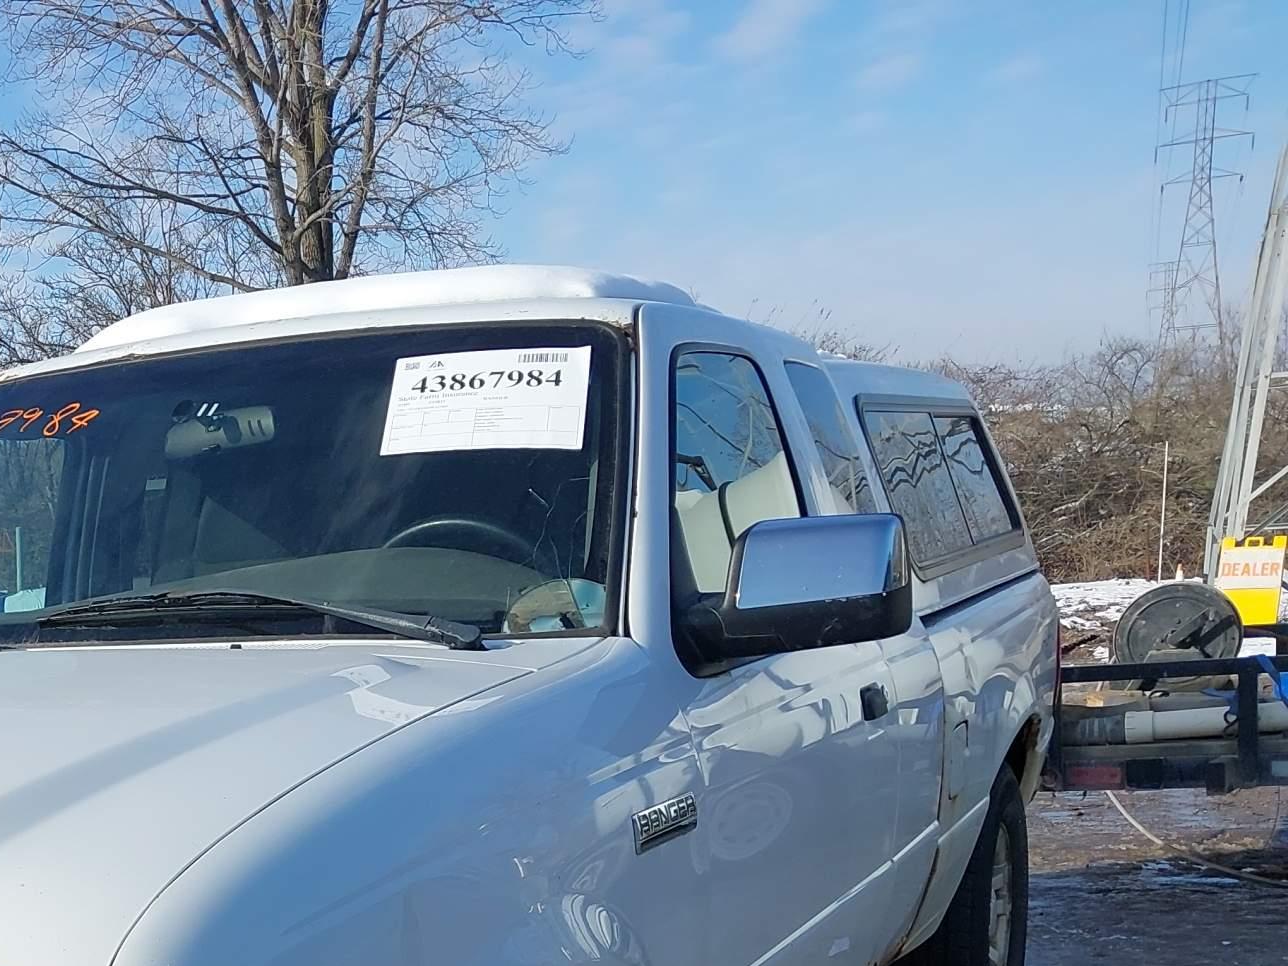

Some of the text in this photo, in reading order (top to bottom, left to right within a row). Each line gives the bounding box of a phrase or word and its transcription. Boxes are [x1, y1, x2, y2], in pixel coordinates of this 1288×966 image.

[411, 368, 563, 394] 43867984
[1222, 562, 1280, 577] DEALER
[637, 795, 697, 837] RANGER
